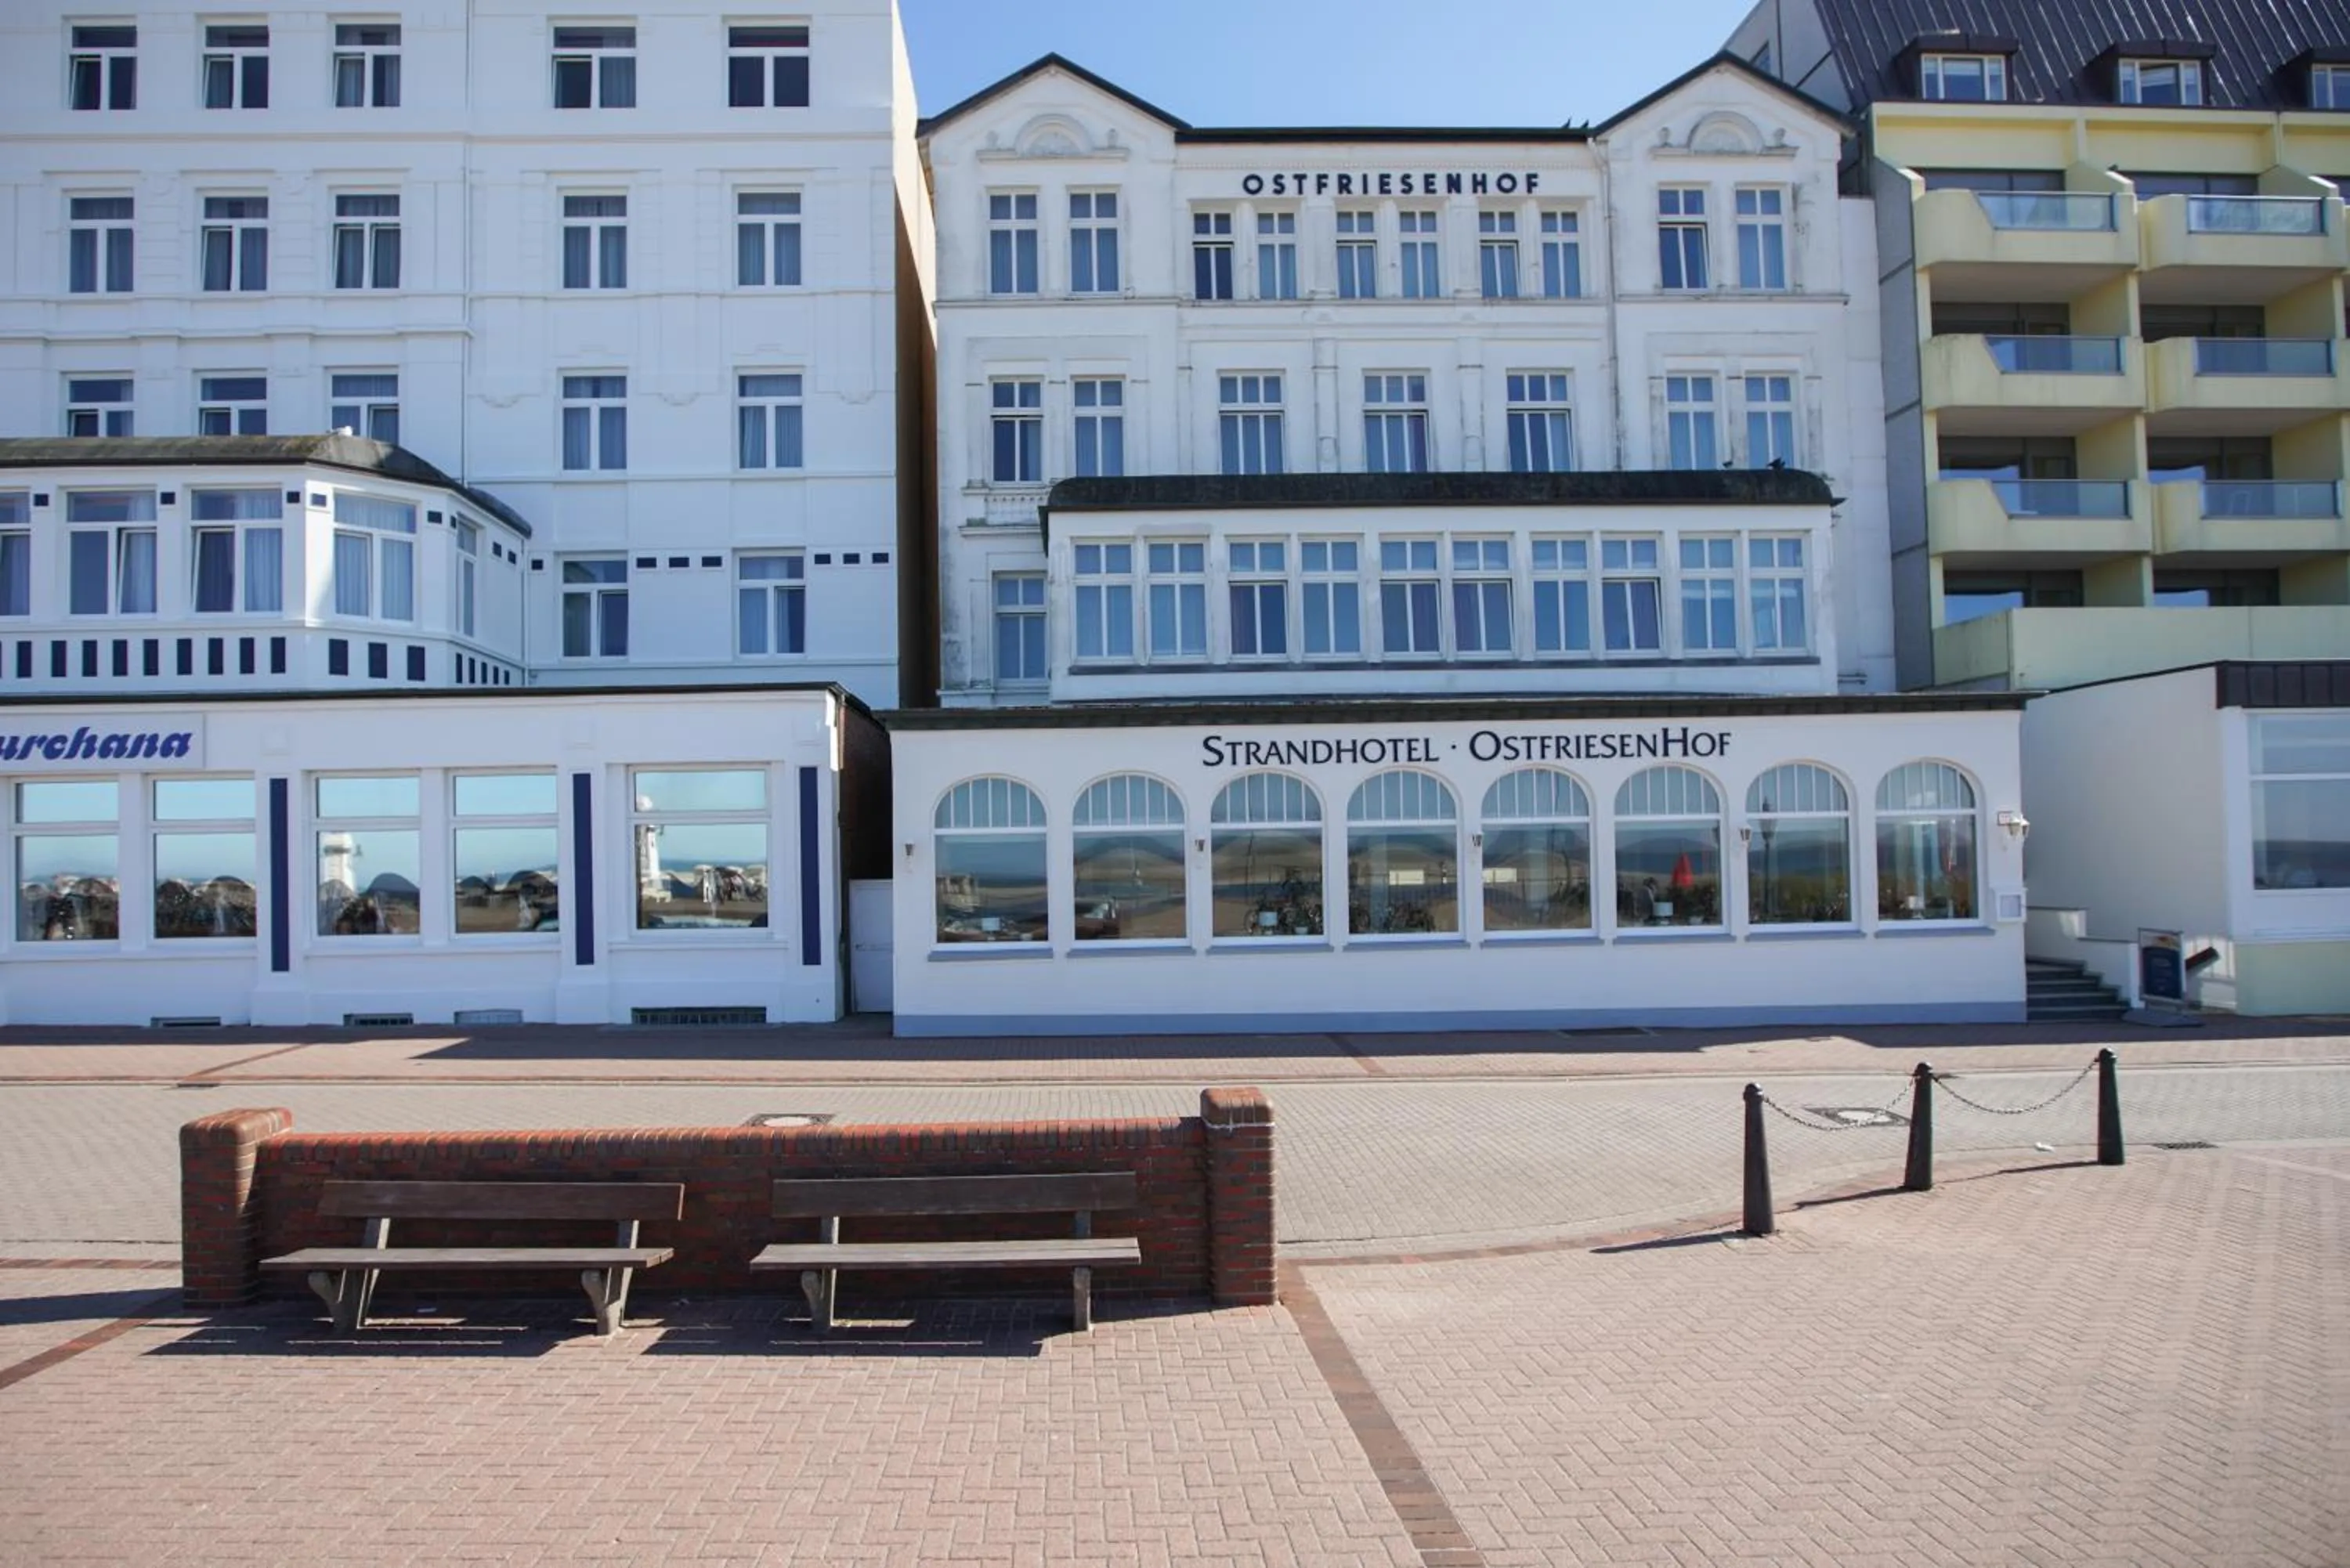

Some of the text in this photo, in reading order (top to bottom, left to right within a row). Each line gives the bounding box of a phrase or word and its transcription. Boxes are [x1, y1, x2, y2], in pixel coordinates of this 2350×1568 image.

[1242, 172, 1540, 196] OSTFRIESENHOF
[1202, 726, 1733, 767] STRANDHOTEL OSTFRIESENHOF
